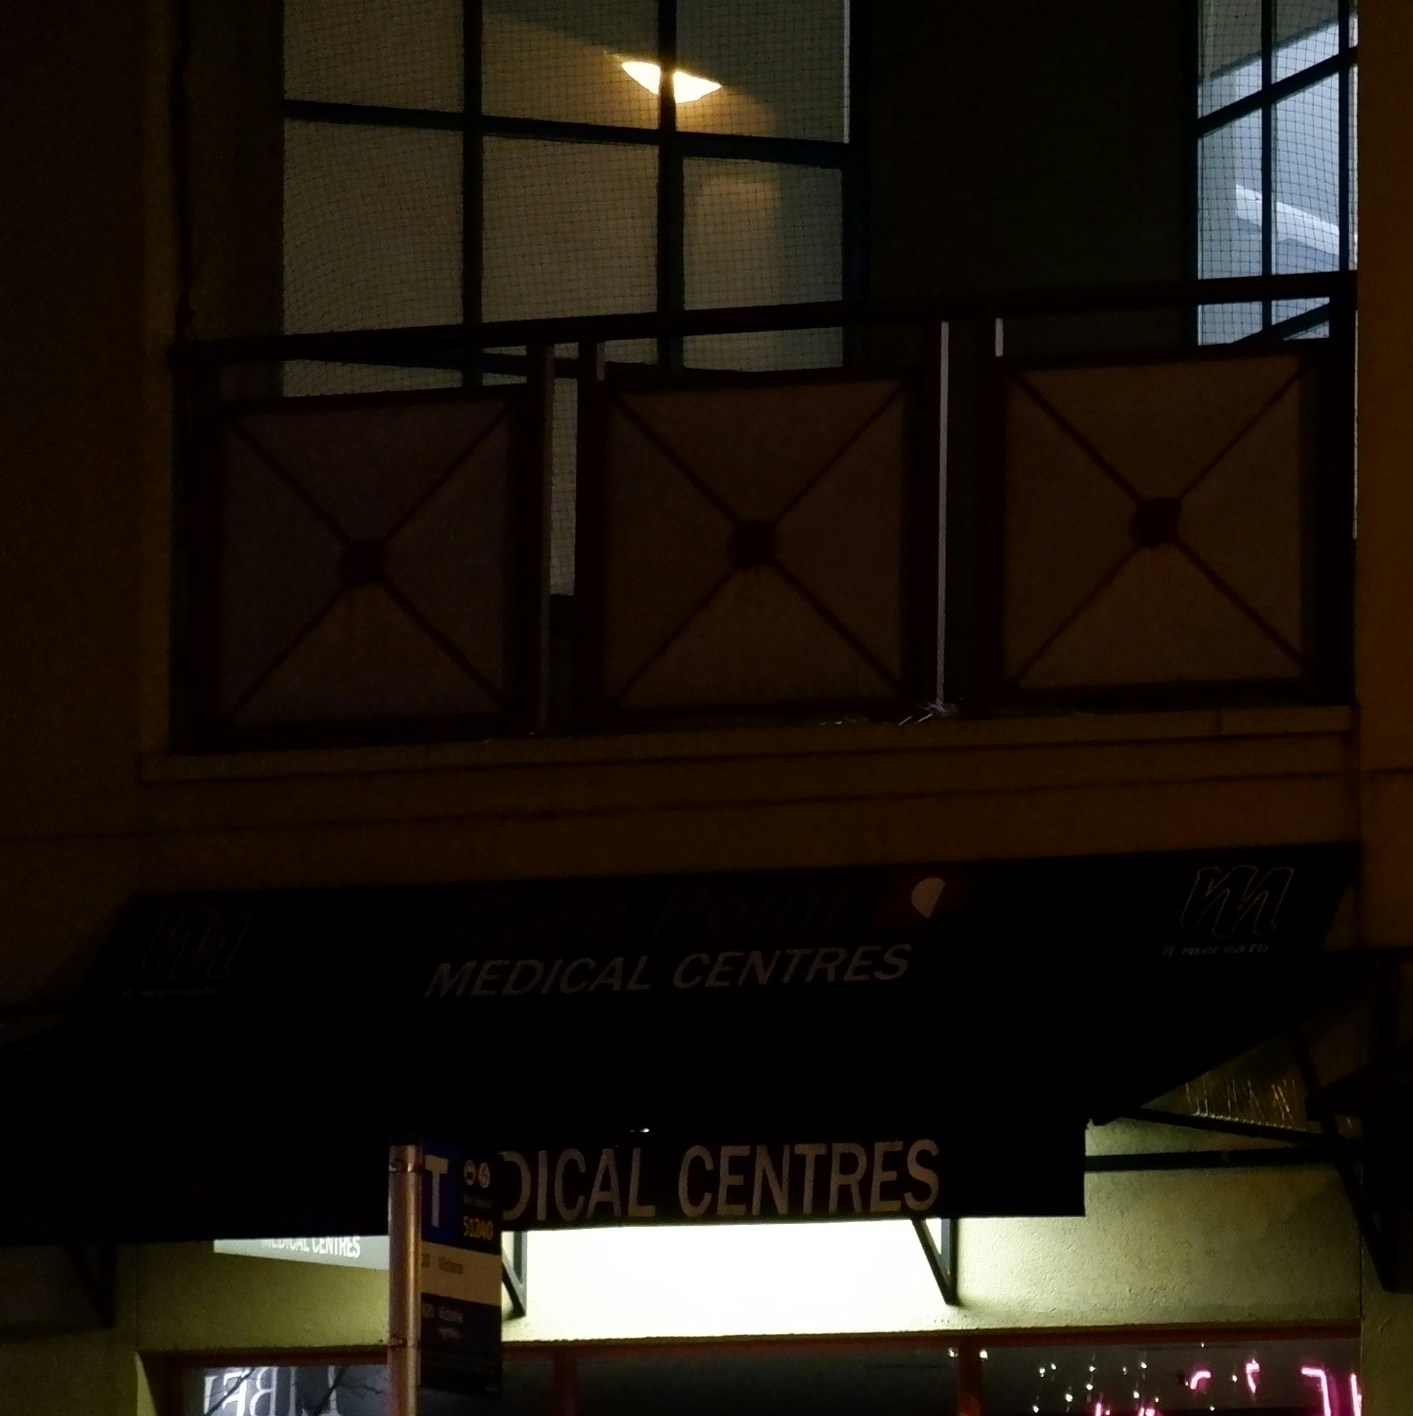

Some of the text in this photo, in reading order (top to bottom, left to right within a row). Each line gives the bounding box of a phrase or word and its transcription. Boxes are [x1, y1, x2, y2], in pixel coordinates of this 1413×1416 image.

[423, 944, 912, 1000] MEDICAL CENTRES
[424, 1154, 449, 1227] T
[500, 1139, 942, 1222] DICAL CENTRES
